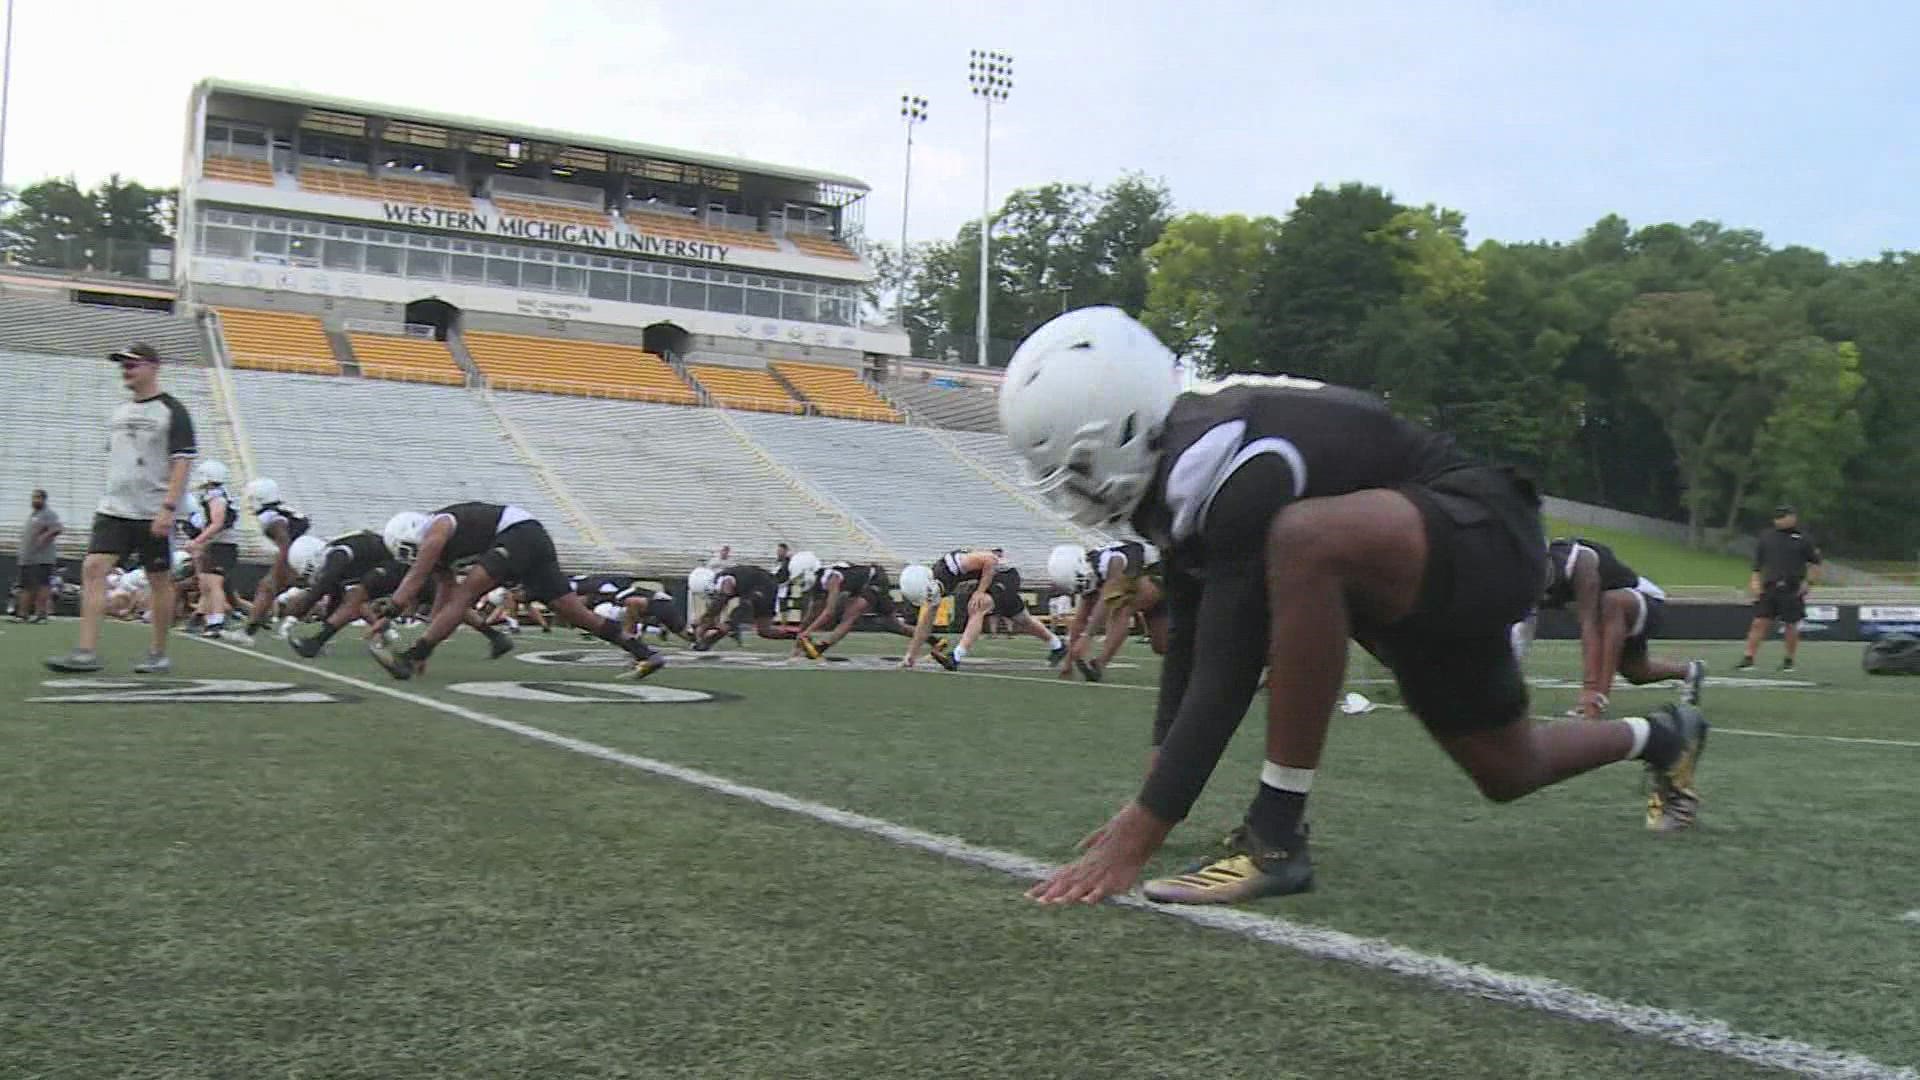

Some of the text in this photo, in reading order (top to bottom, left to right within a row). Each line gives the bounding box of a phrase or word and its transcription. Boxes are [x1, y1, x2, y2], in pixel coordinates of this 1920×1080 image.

[383, 202, 729, 262] WESTERN MICHIGAN UNIVERSITY
